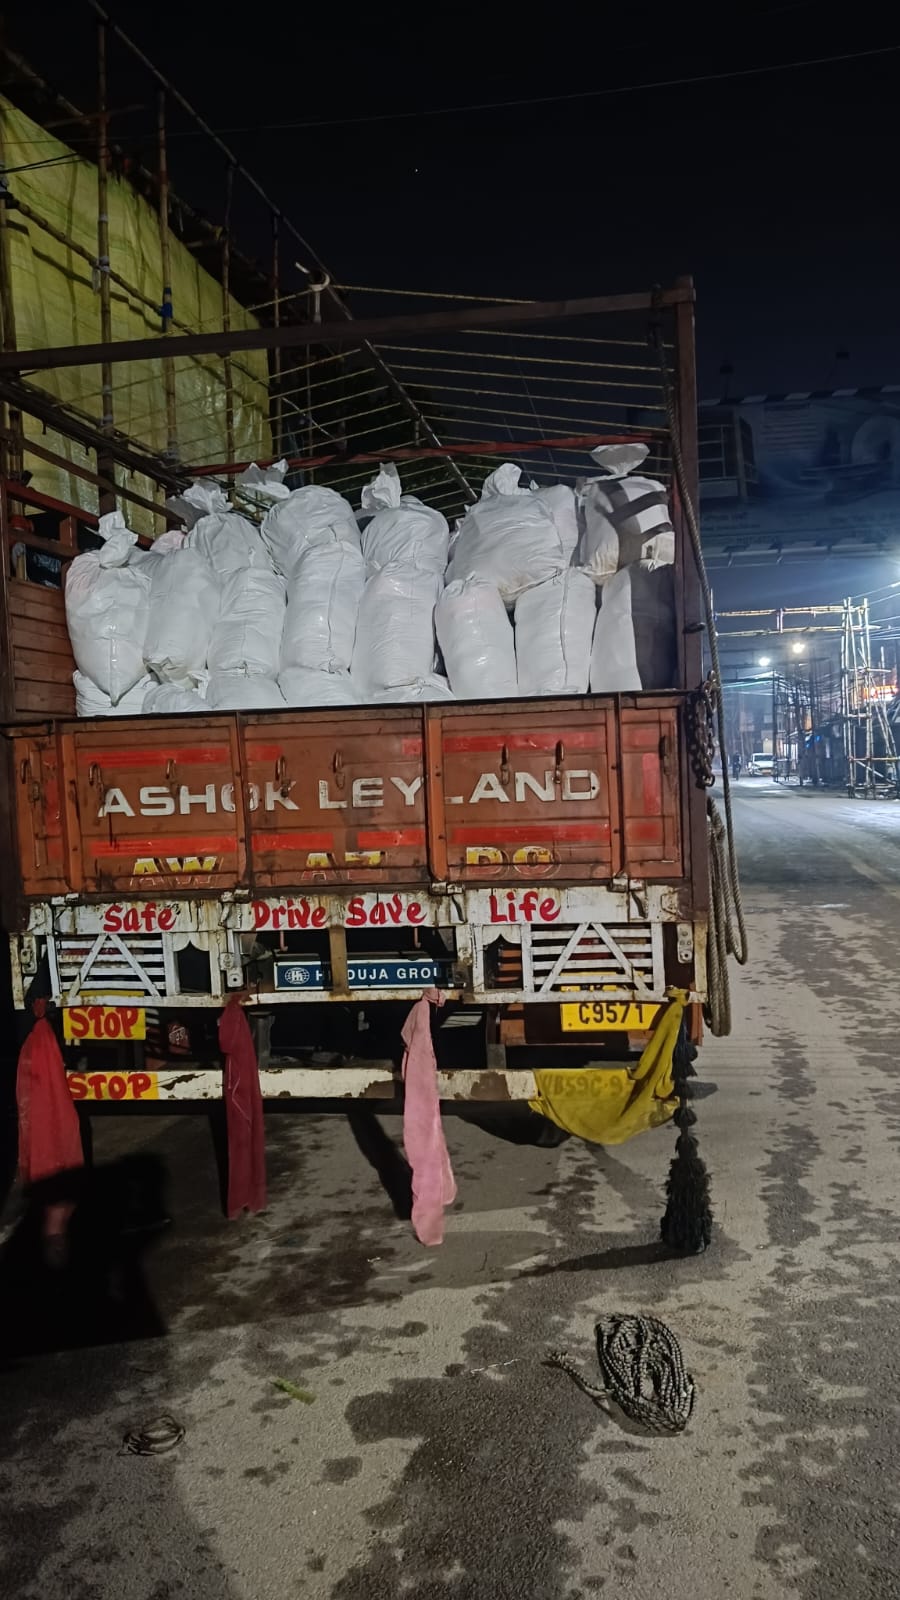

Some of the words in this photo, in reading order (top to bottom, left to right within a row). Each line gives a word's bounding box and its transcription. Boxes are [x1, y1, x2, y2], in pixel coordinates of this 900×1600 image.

[103, 902, 177, 933] Safe
[252, 899, 331, 930] Drive
[346, 893, 428, 927] Save
[489, 889, 561, 924] Life
[69, 1007, 139, 1038] STOP
[67, 1073, 152, 1100] STOP
